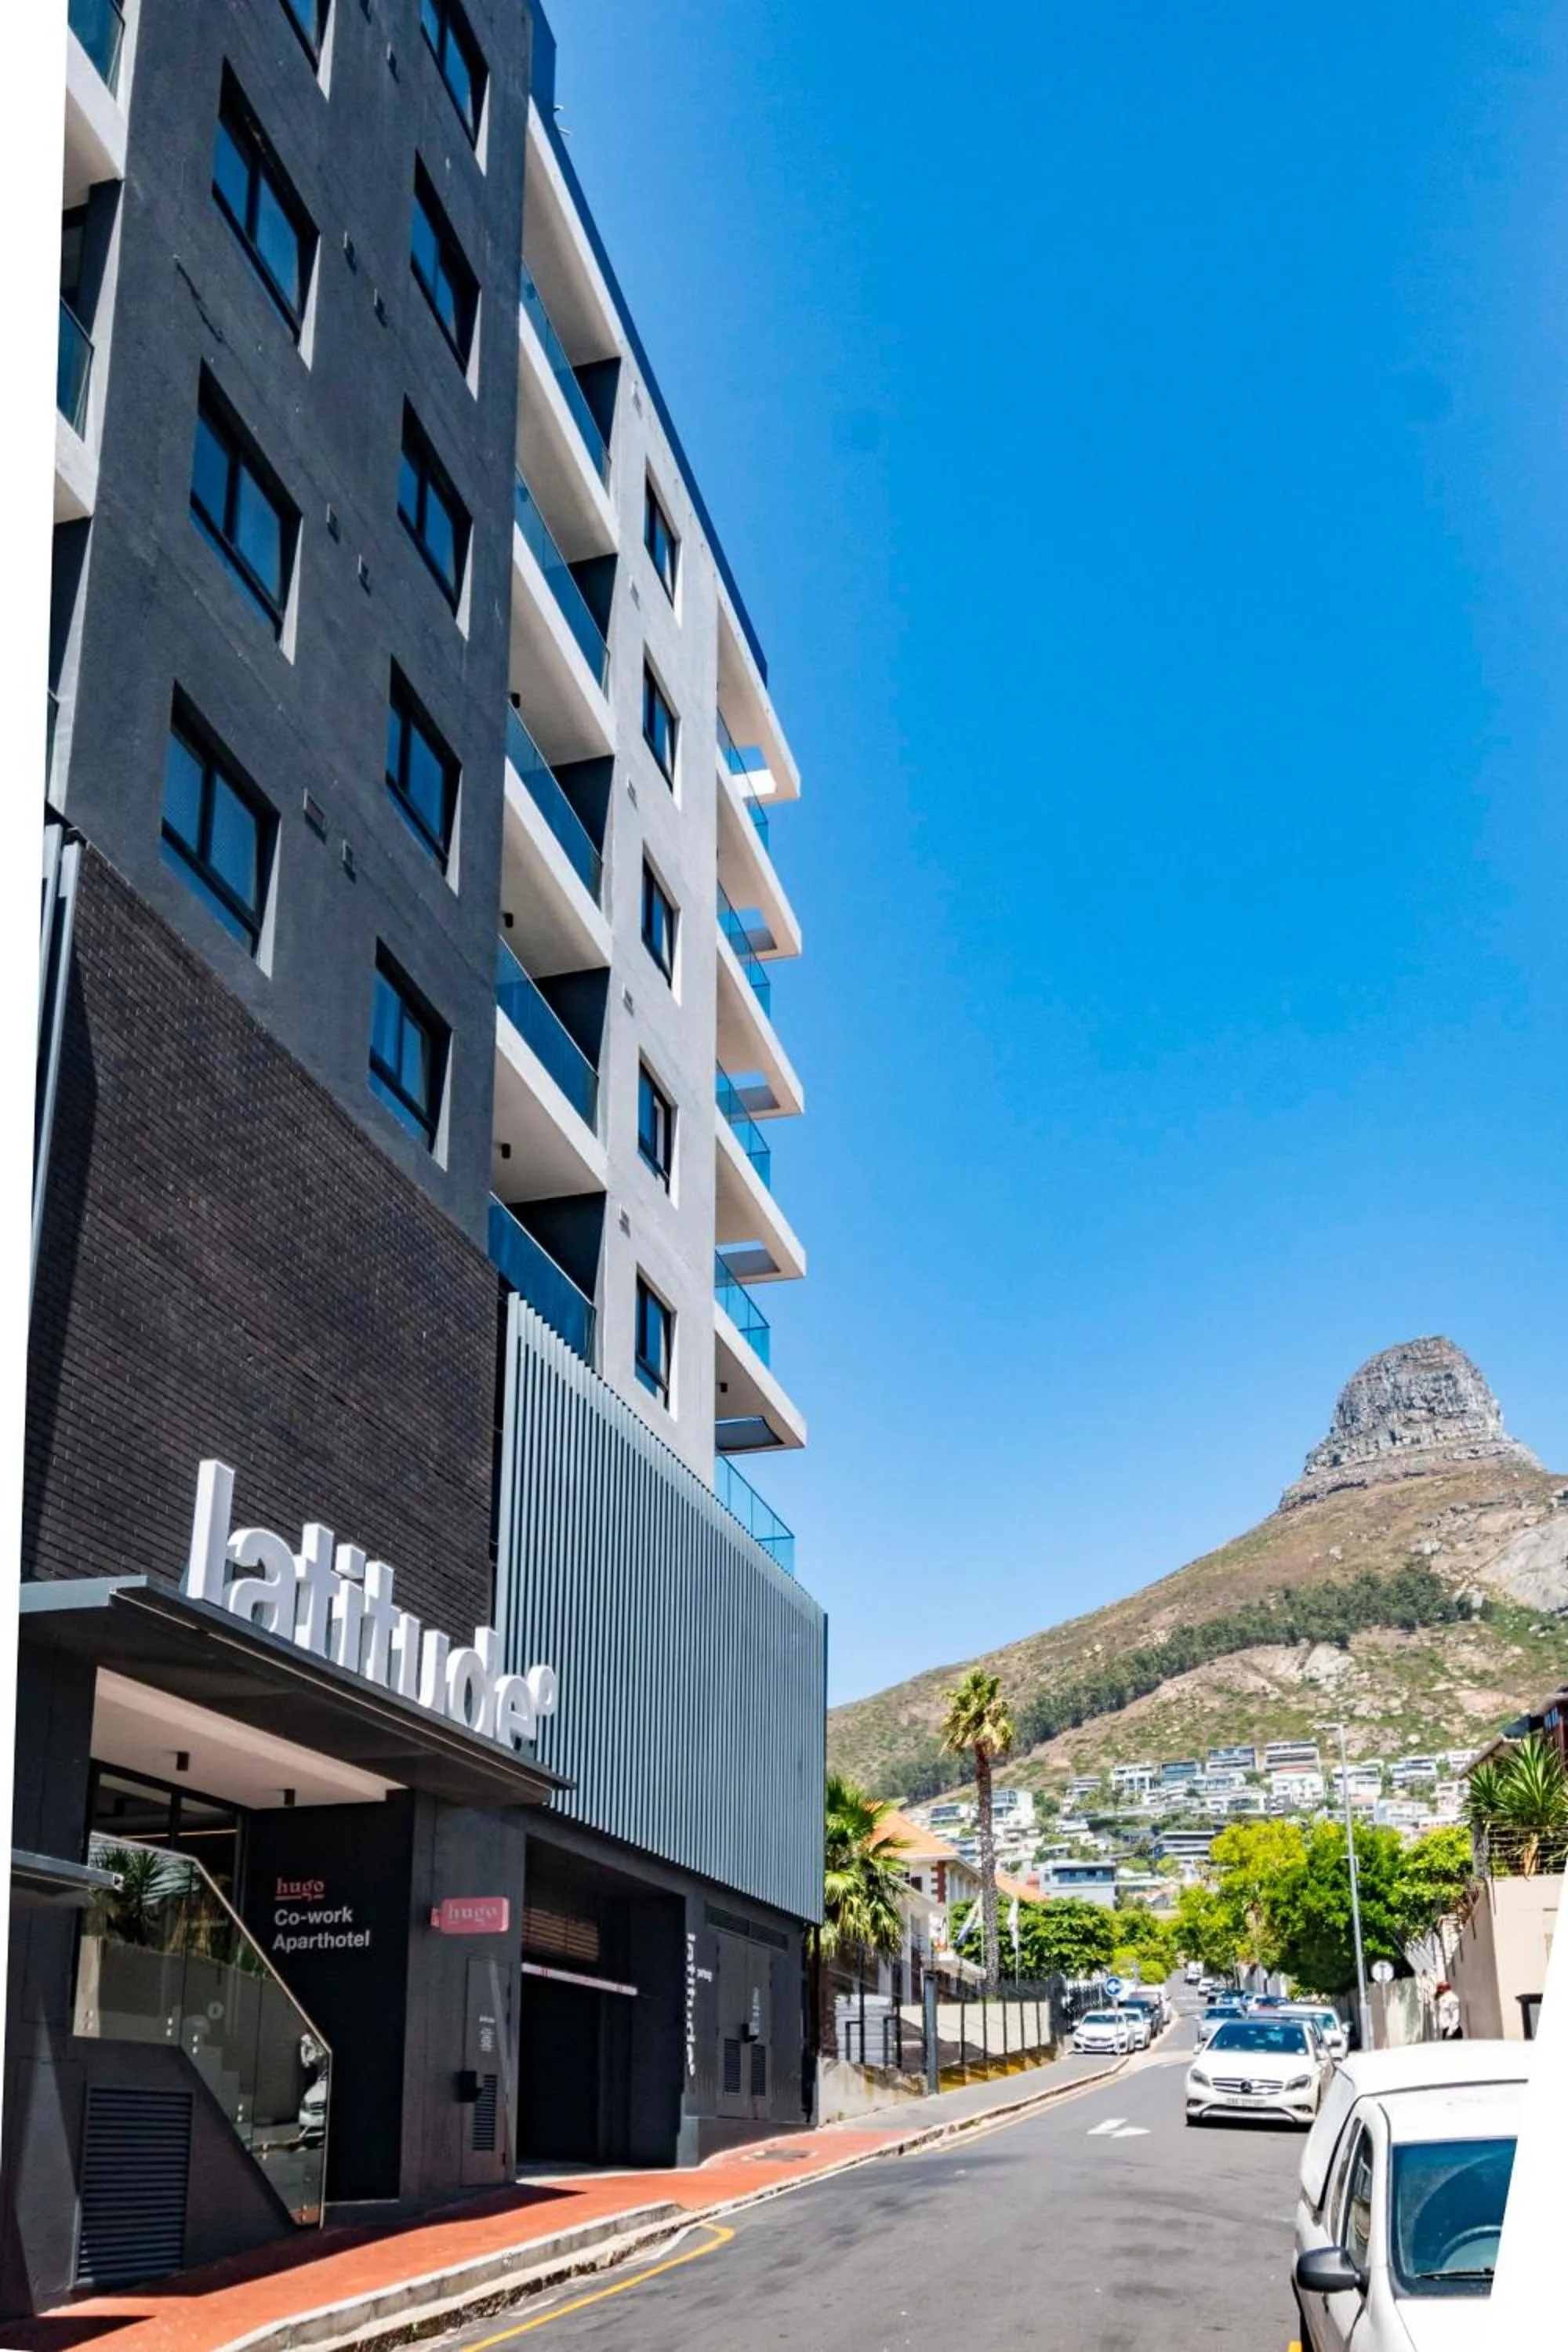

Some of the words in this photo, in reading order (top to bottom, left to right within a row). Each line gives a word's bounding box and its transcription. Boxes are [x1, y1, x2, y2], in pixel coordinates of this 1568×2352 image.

[276, 1878, 325, 1900] hugo
[274, 1906, 353, 1926] Co-work
[448, 1904, 498, 1926] hugo
[273, 1929, 371, 1952] Aparthotel
